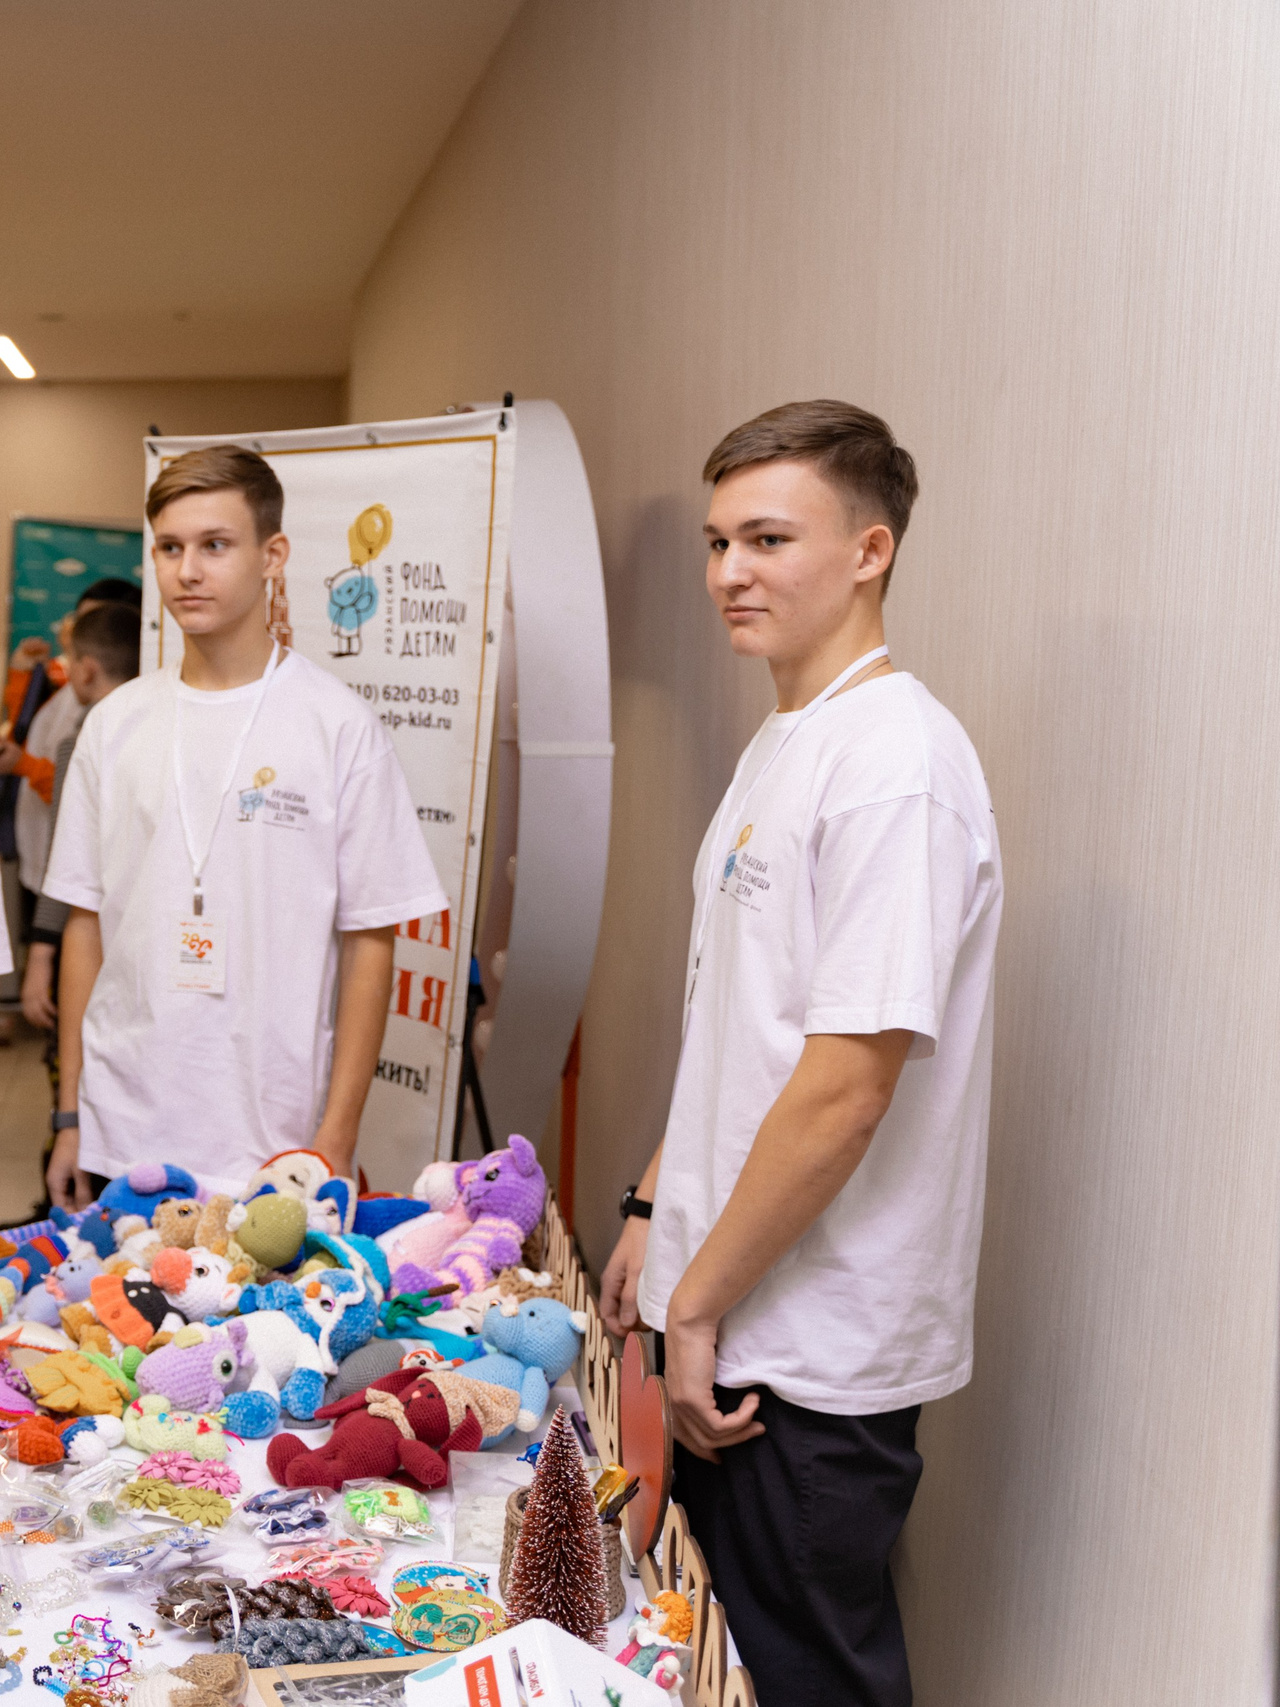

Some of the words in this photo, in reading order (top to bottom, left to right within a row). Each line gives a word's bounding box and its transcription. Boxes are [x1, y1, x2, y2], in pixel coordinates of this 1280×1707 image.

[401, 561, 446, 591] ФОНД
[400, 597, 467, 627] ПОМОЩИ
[399, 631, 456, 658] ДЕТЯМ
[382, 684, 460, 706] 620-03-03
[475, 1666, 489, 1698] ПОМОГАЕМ
[525, 1661, 539, 1693] СПАСИБО
